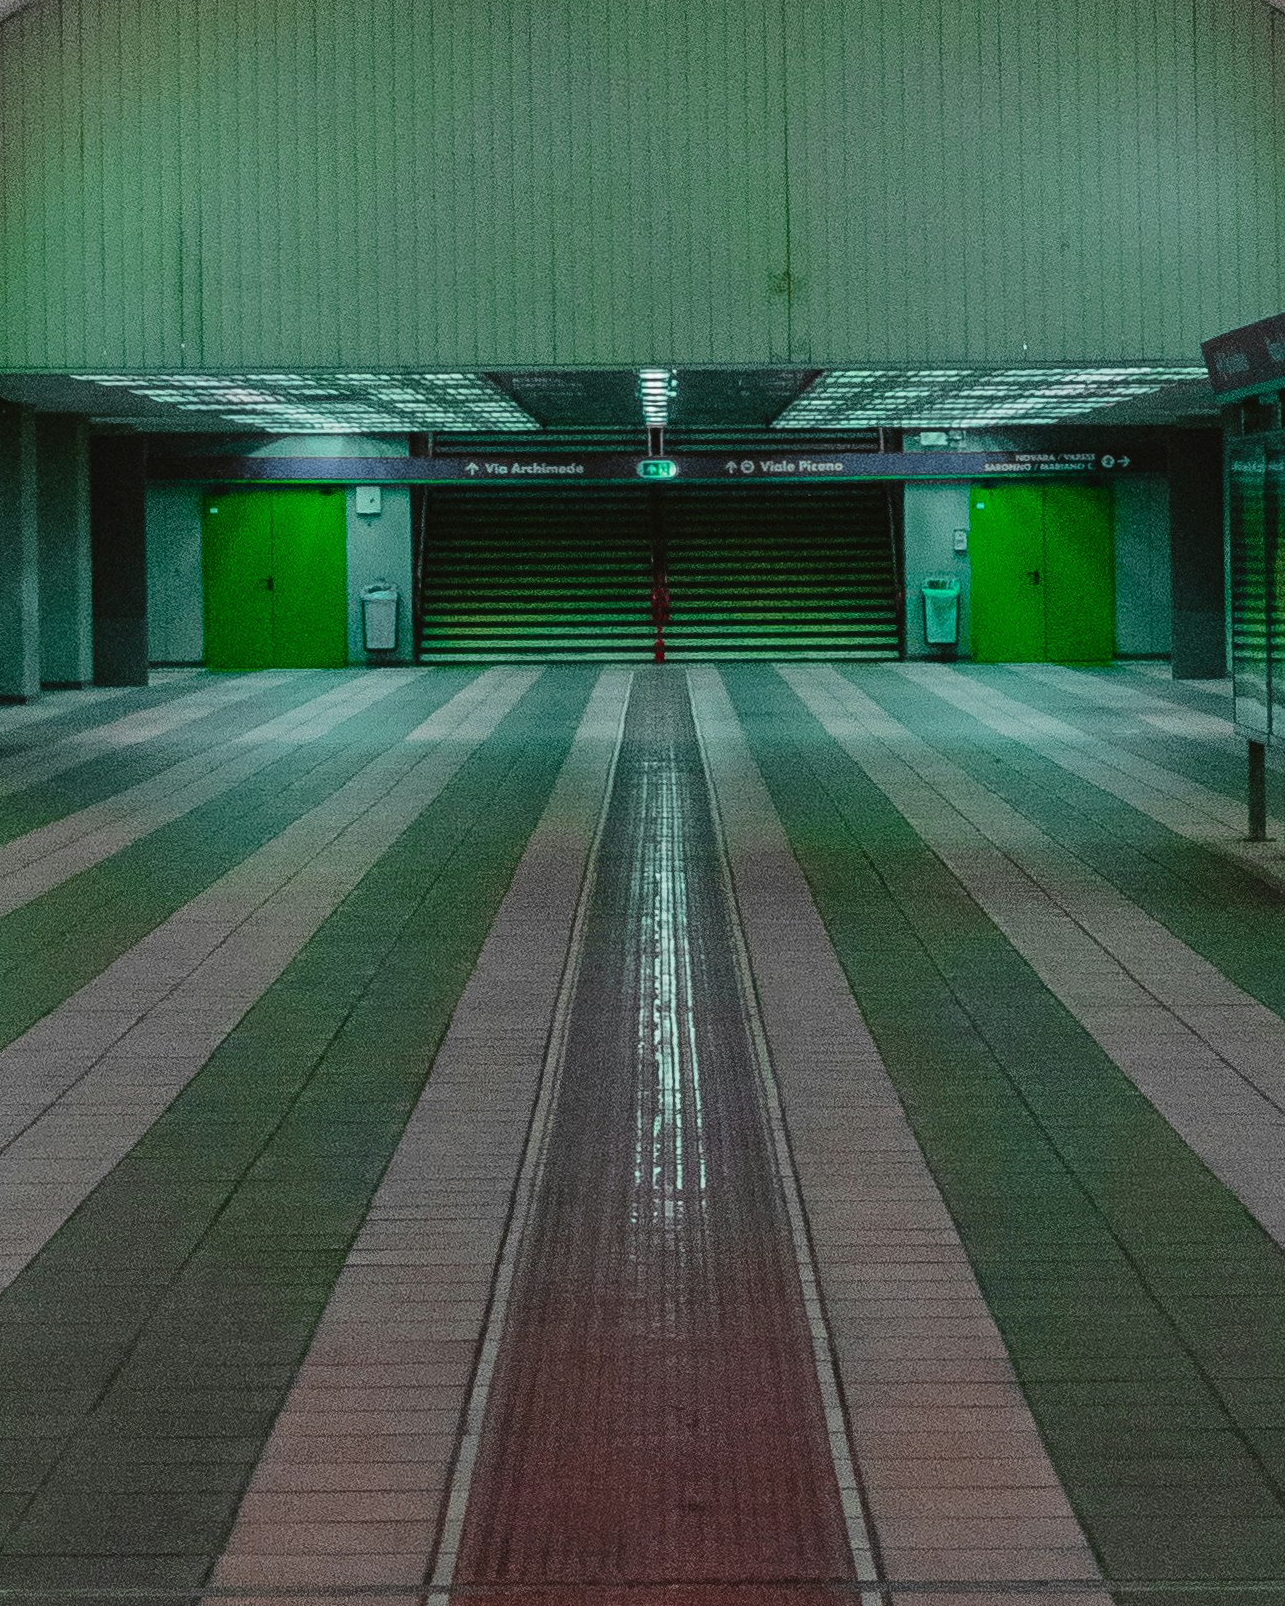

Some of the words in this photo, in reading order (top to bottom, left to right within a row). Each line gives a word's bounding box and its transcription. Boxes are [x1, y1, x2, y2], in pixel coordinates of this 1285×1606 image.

[485, 462, 508, 474] Via
[511, 462, 584, 474] Archimede
[760, 460, 795, 472] Viale
